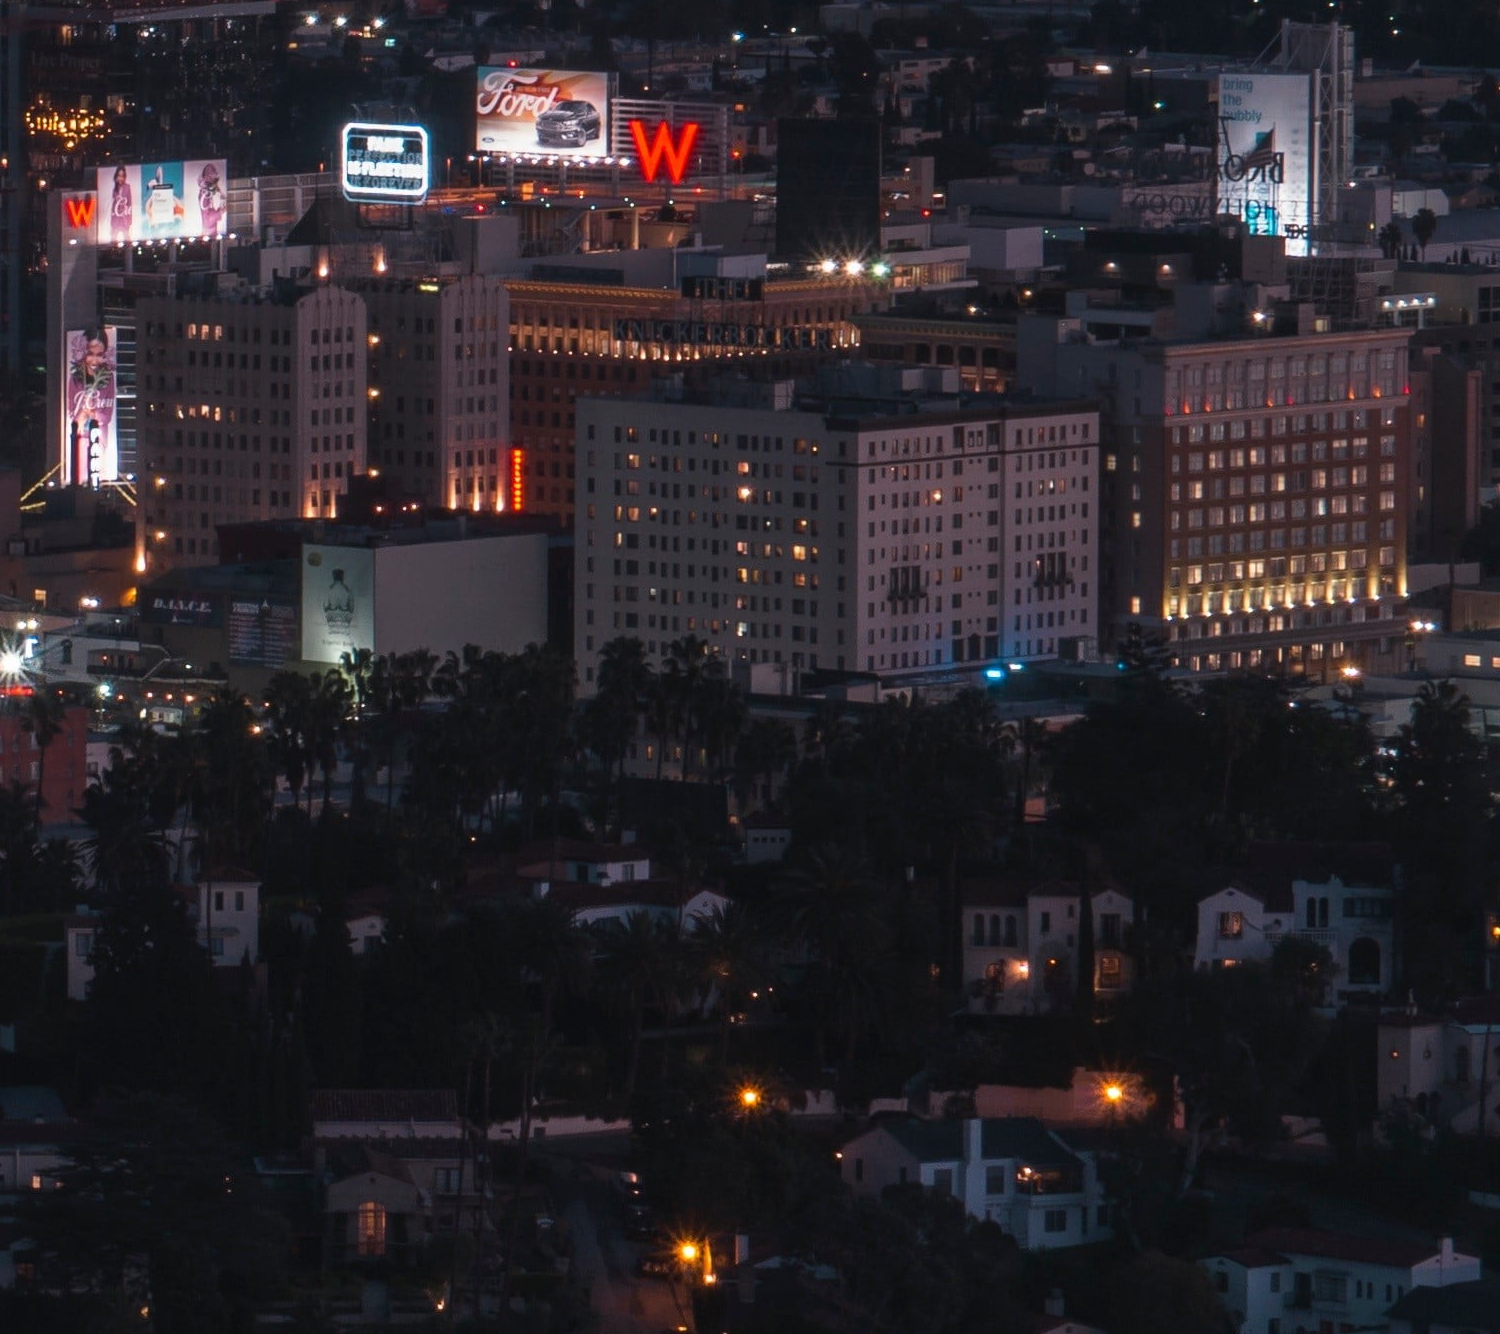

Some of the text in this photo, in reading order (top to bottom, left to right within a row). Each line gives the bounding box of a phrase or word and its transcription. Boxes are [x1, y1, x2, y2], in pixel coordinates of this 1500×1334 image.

[477, 71, 559, 117] Ford
[1222, 78, 1254, 93] bring
[1222, 93, 1242, 107] the
[1222, 107, 1264, 124] bubbly
[348, 149, 423, 165] PERFECTION
[629, 120, 699, 184] W
[67, 198, 97, 228] W
[705, 279, 747, 300] THE
[614, 319, 832, 351] KNICKERBOCKER
